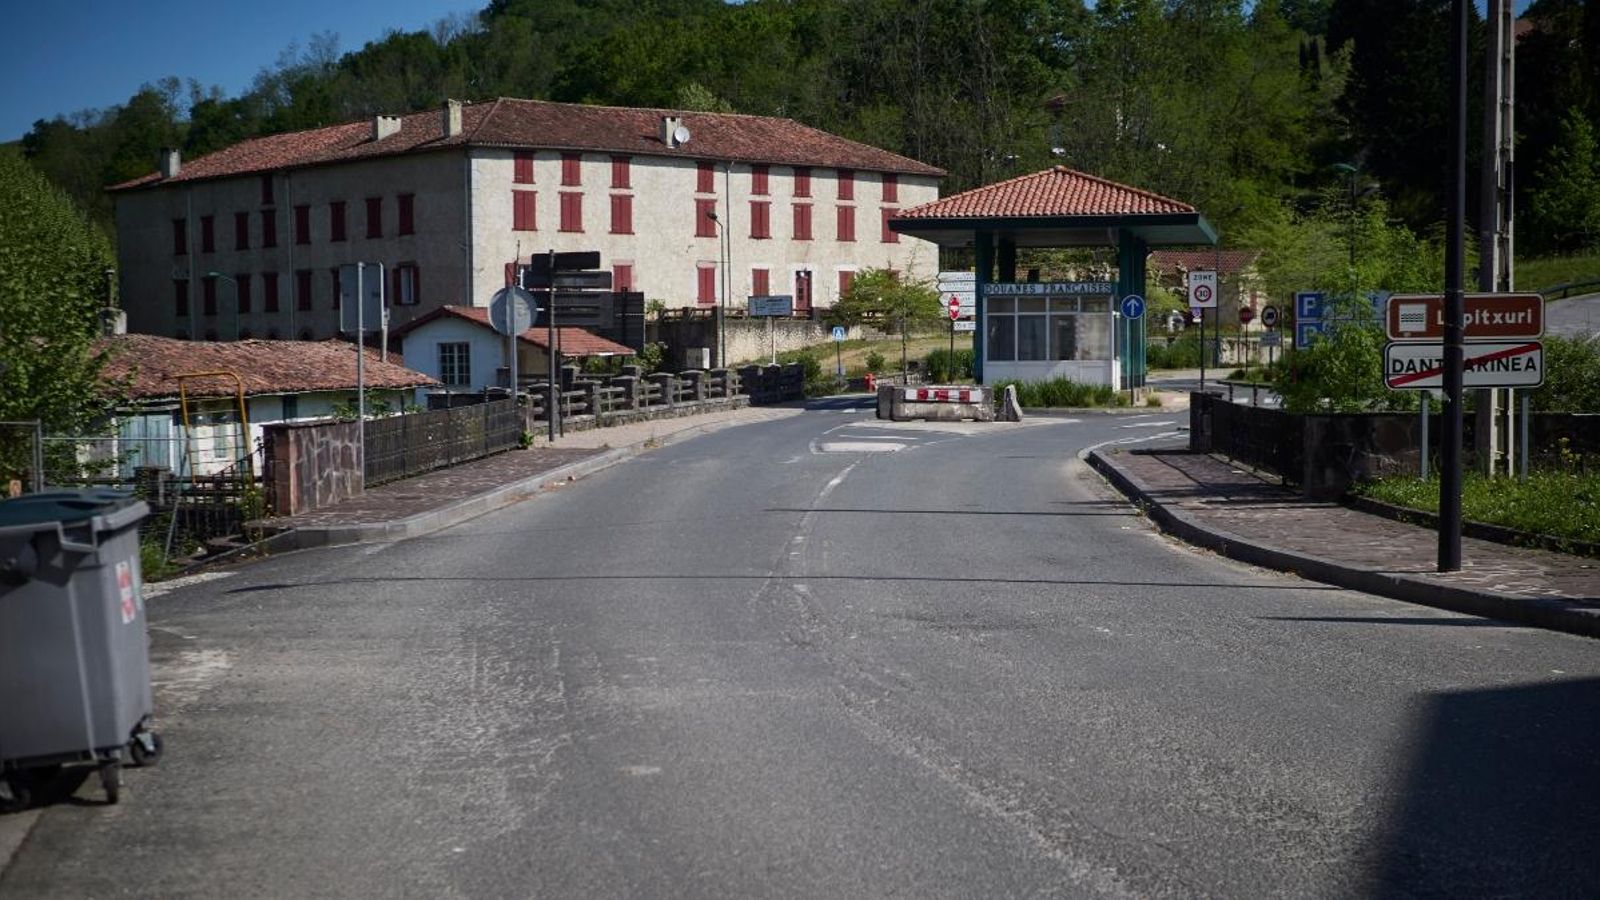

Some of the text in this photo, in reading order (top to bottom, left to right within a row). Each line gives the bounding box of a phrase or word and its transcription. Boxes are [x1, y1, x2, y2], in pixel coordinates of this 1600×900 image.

[984, 282, 1036, 294] DOUANES
[1303, 297, 1316, 316] P
[1437, 308, 1532, 329] Lpitxuri
[1393, 357, 1537, 374] DANTARINEA
